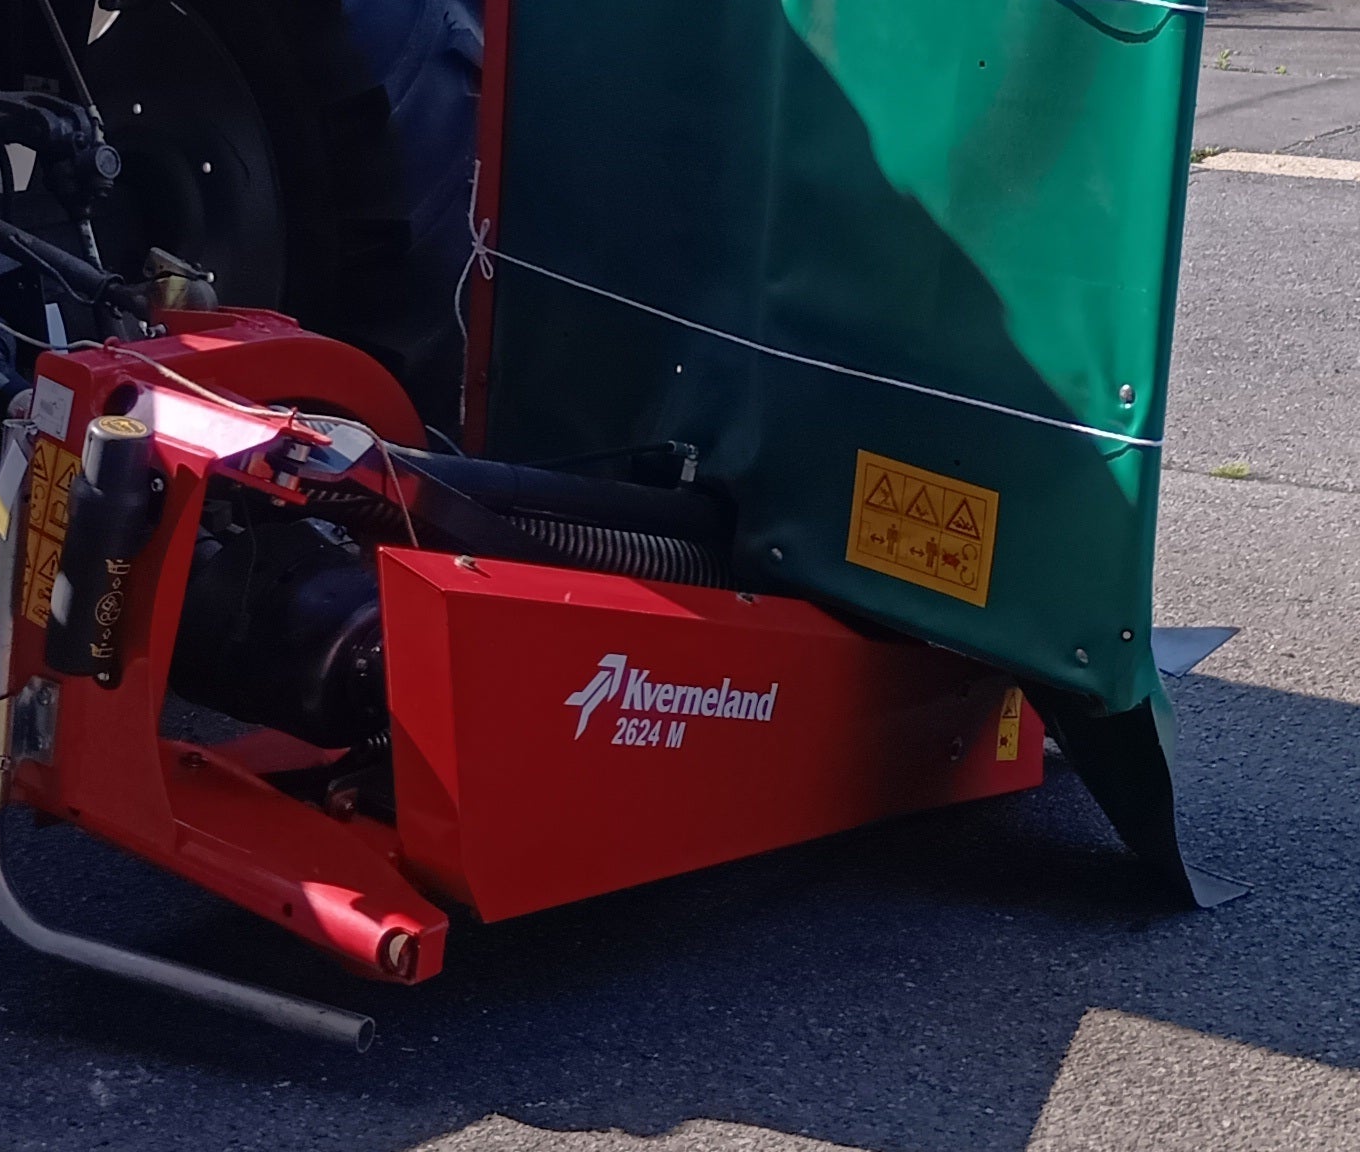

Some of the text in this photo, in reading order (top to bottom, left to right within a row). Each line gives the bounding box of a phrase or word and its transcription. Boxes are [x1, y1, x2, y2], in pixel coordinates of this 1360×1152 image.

[621, 668, 779, 722] Kverneland
[611, 717, 687, 748] 2624 M
